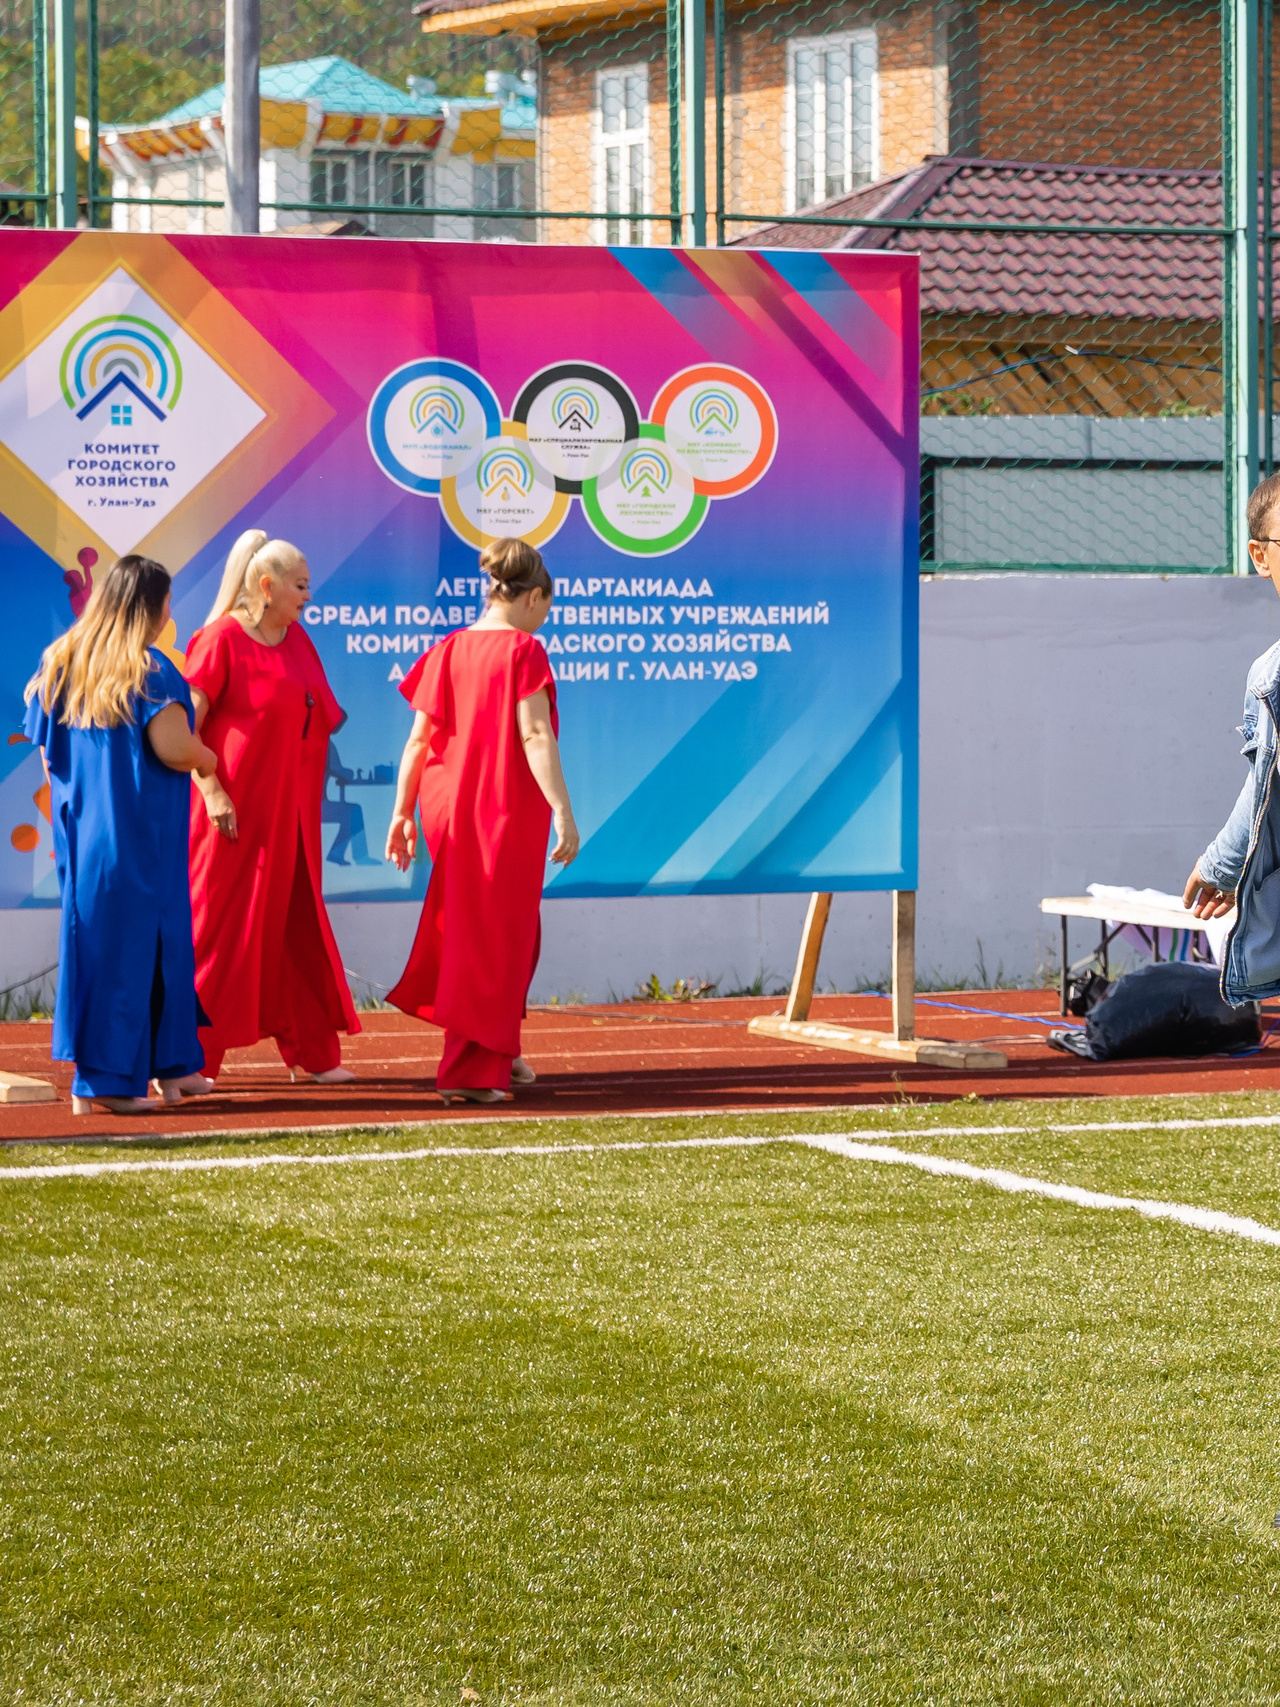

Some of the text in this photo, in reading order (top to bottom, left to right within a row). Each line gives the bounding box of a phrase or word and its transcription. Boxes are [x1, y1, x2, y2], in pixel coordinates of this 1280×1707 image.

[84, 443, 160, 455] КОМИТЕТ
[67, 459, 176, 473] ГОРОДСКОГО
[75, 473, 169, 488] ХОЗЯЙСТВА
[87, 497, 156, 508] г. Улан-Удэ
[554, 577, 714, 599] ПАРТАКИАДА
[304, 604, 387, 627] СРЕДИ
[670, 601, 830, 627] УЧРЕЖДЕНИЙ
[346, 633, 447, 655] КОМИТ
[651, 628, 792, 655] ХОЗЯЙСТВА
[617, 661, 636, 681] Г.
[641, 661, 758, 683] УЛАН-УДЭ
